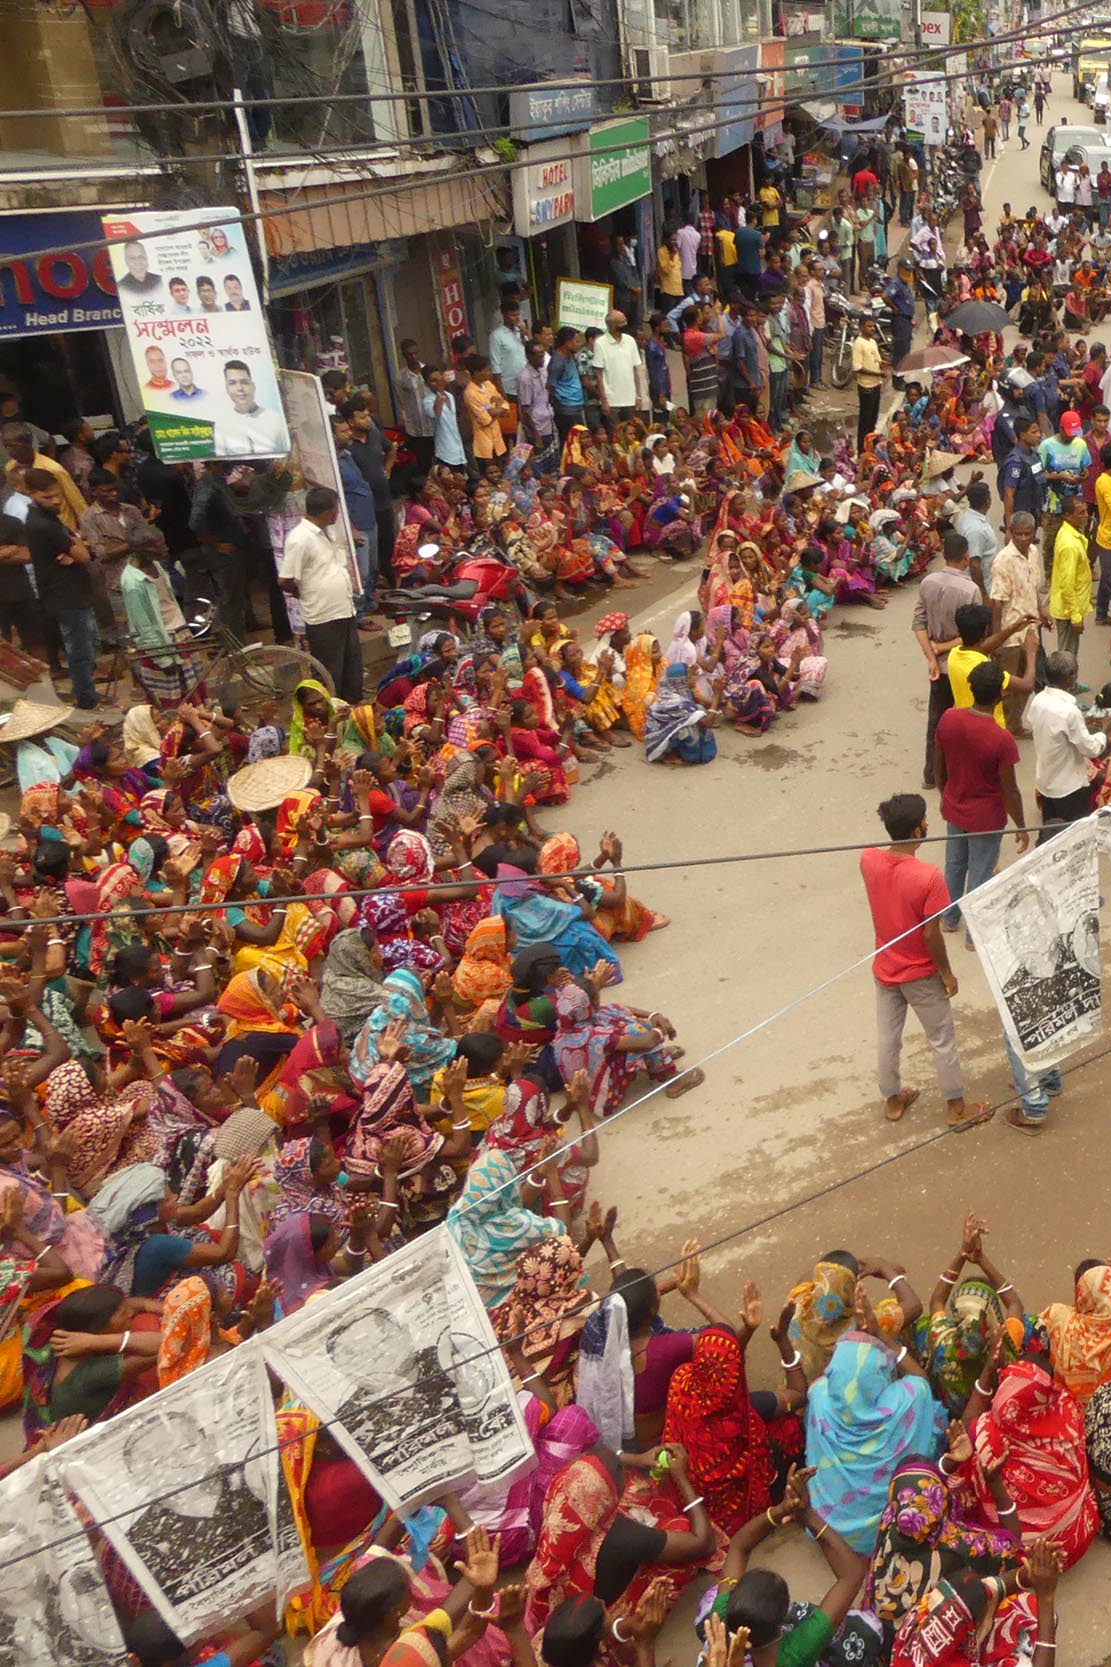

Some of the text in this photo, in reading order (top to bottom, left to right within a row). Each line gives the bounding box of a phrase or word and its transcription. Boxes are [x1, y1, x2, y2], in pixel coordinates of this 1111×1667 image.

[542, 162, 567, 188] HOTEL
[25, 309, 68, 327] Head
[131, 301, 165, 318] বার্ষিক
[134, 318, 210, 341] সম্মেলন
[180, 336, 214, 349] ২০২২
[1023, 1006, 1079, 1046] পরিমল
